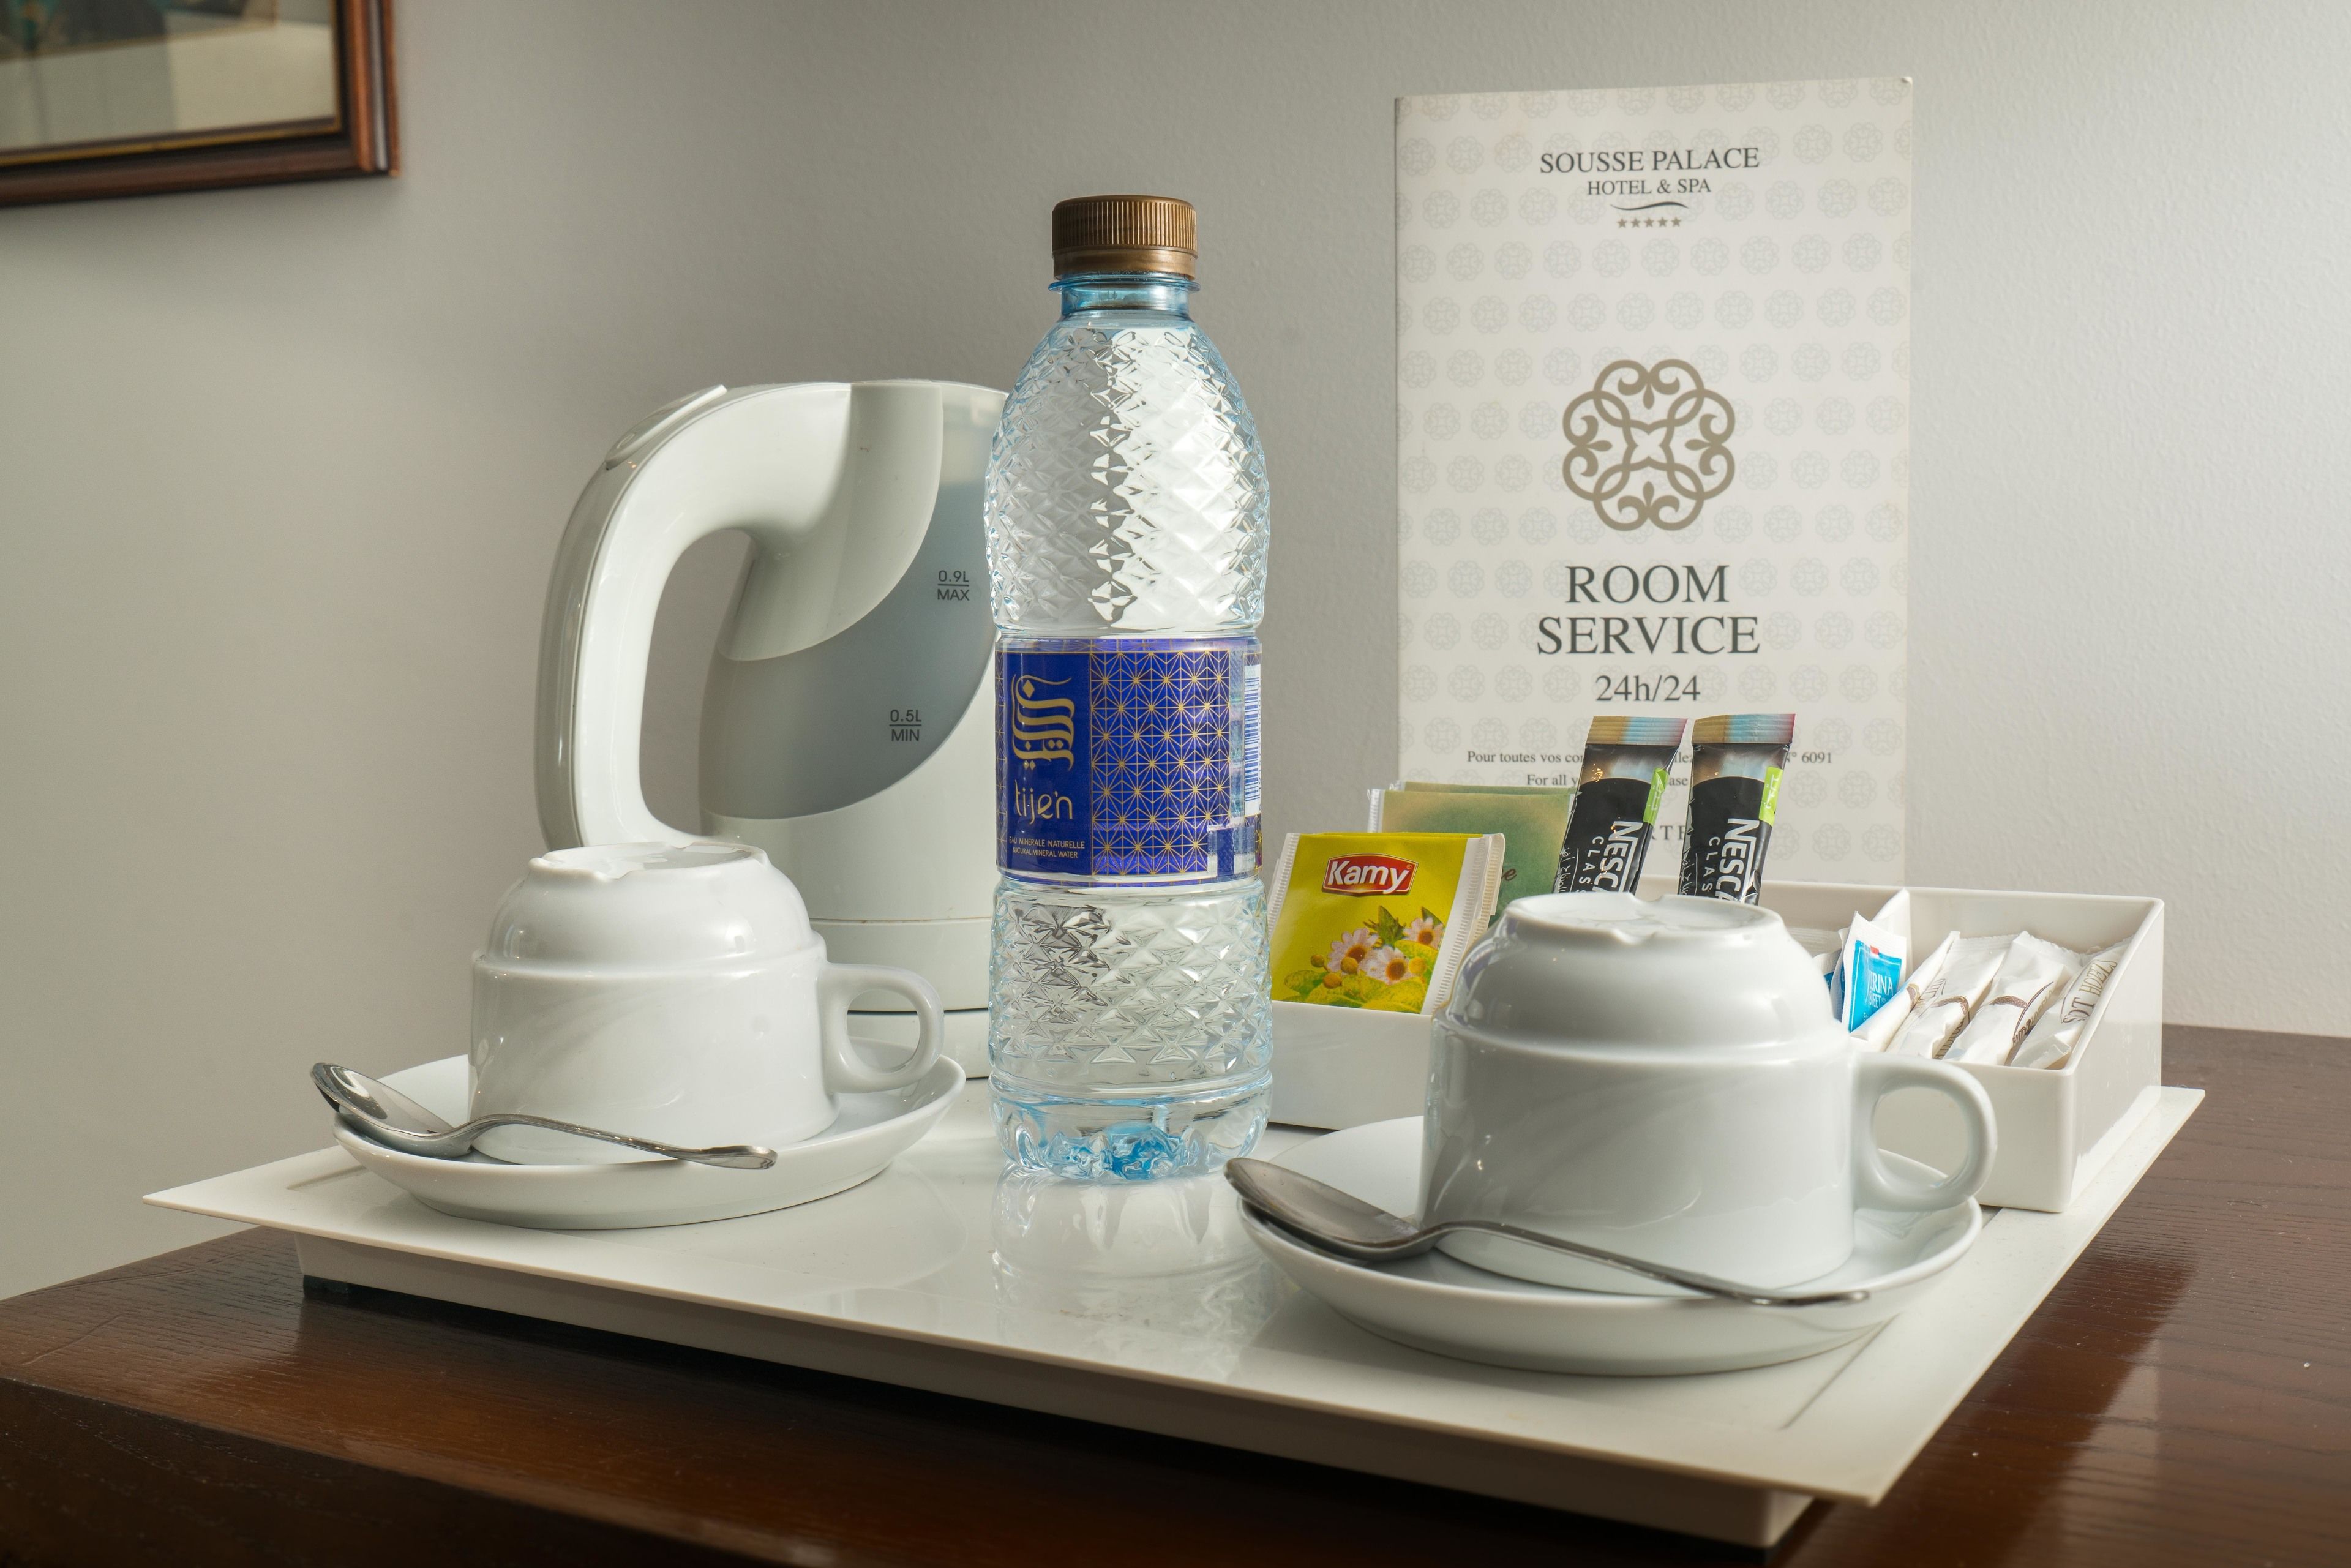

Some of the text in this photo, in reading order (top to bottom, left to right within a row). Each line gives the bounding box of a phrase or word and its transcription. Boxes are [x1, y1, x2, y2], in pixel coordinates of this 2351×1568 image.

[1540, 147, 1760, 173] SOUSSE PALACE
[1588, 178, 1711, 195] HOTEL & SPA
[938, 569, 969, 583] 0.9L
[1565, 565, 1730, 604] ROOM
[937, 588, 970, 601] MAX
[1537, 616, 1760, 655] SERVICE
[1595, 674, 1701, 702] 24h/24
[890, 709, 922, 722] 0.5L
[891, 729, 920, 742] MIN
[1467, 751, 1496, 763] Pour
[1499, 752, 1536, 763] toutes
[1541, 754, 1561, 763] vos
[1802, 751, 1832, 763] 6091
[1526, 774, 1548, 786] For
[1551, 773, 1567, 786] all
[1009, 836, 1086, 849] EAU MINERALE NATURELLE
[1013, 847, 1032, 856] NATURAL
[1032, 849, 1057, 857] MINERAL
[1593, 820, 1644, 893] NESC
[1577, 836, 1605, 893] CLAS
[1701, 836, 1721, 893] CLAS
